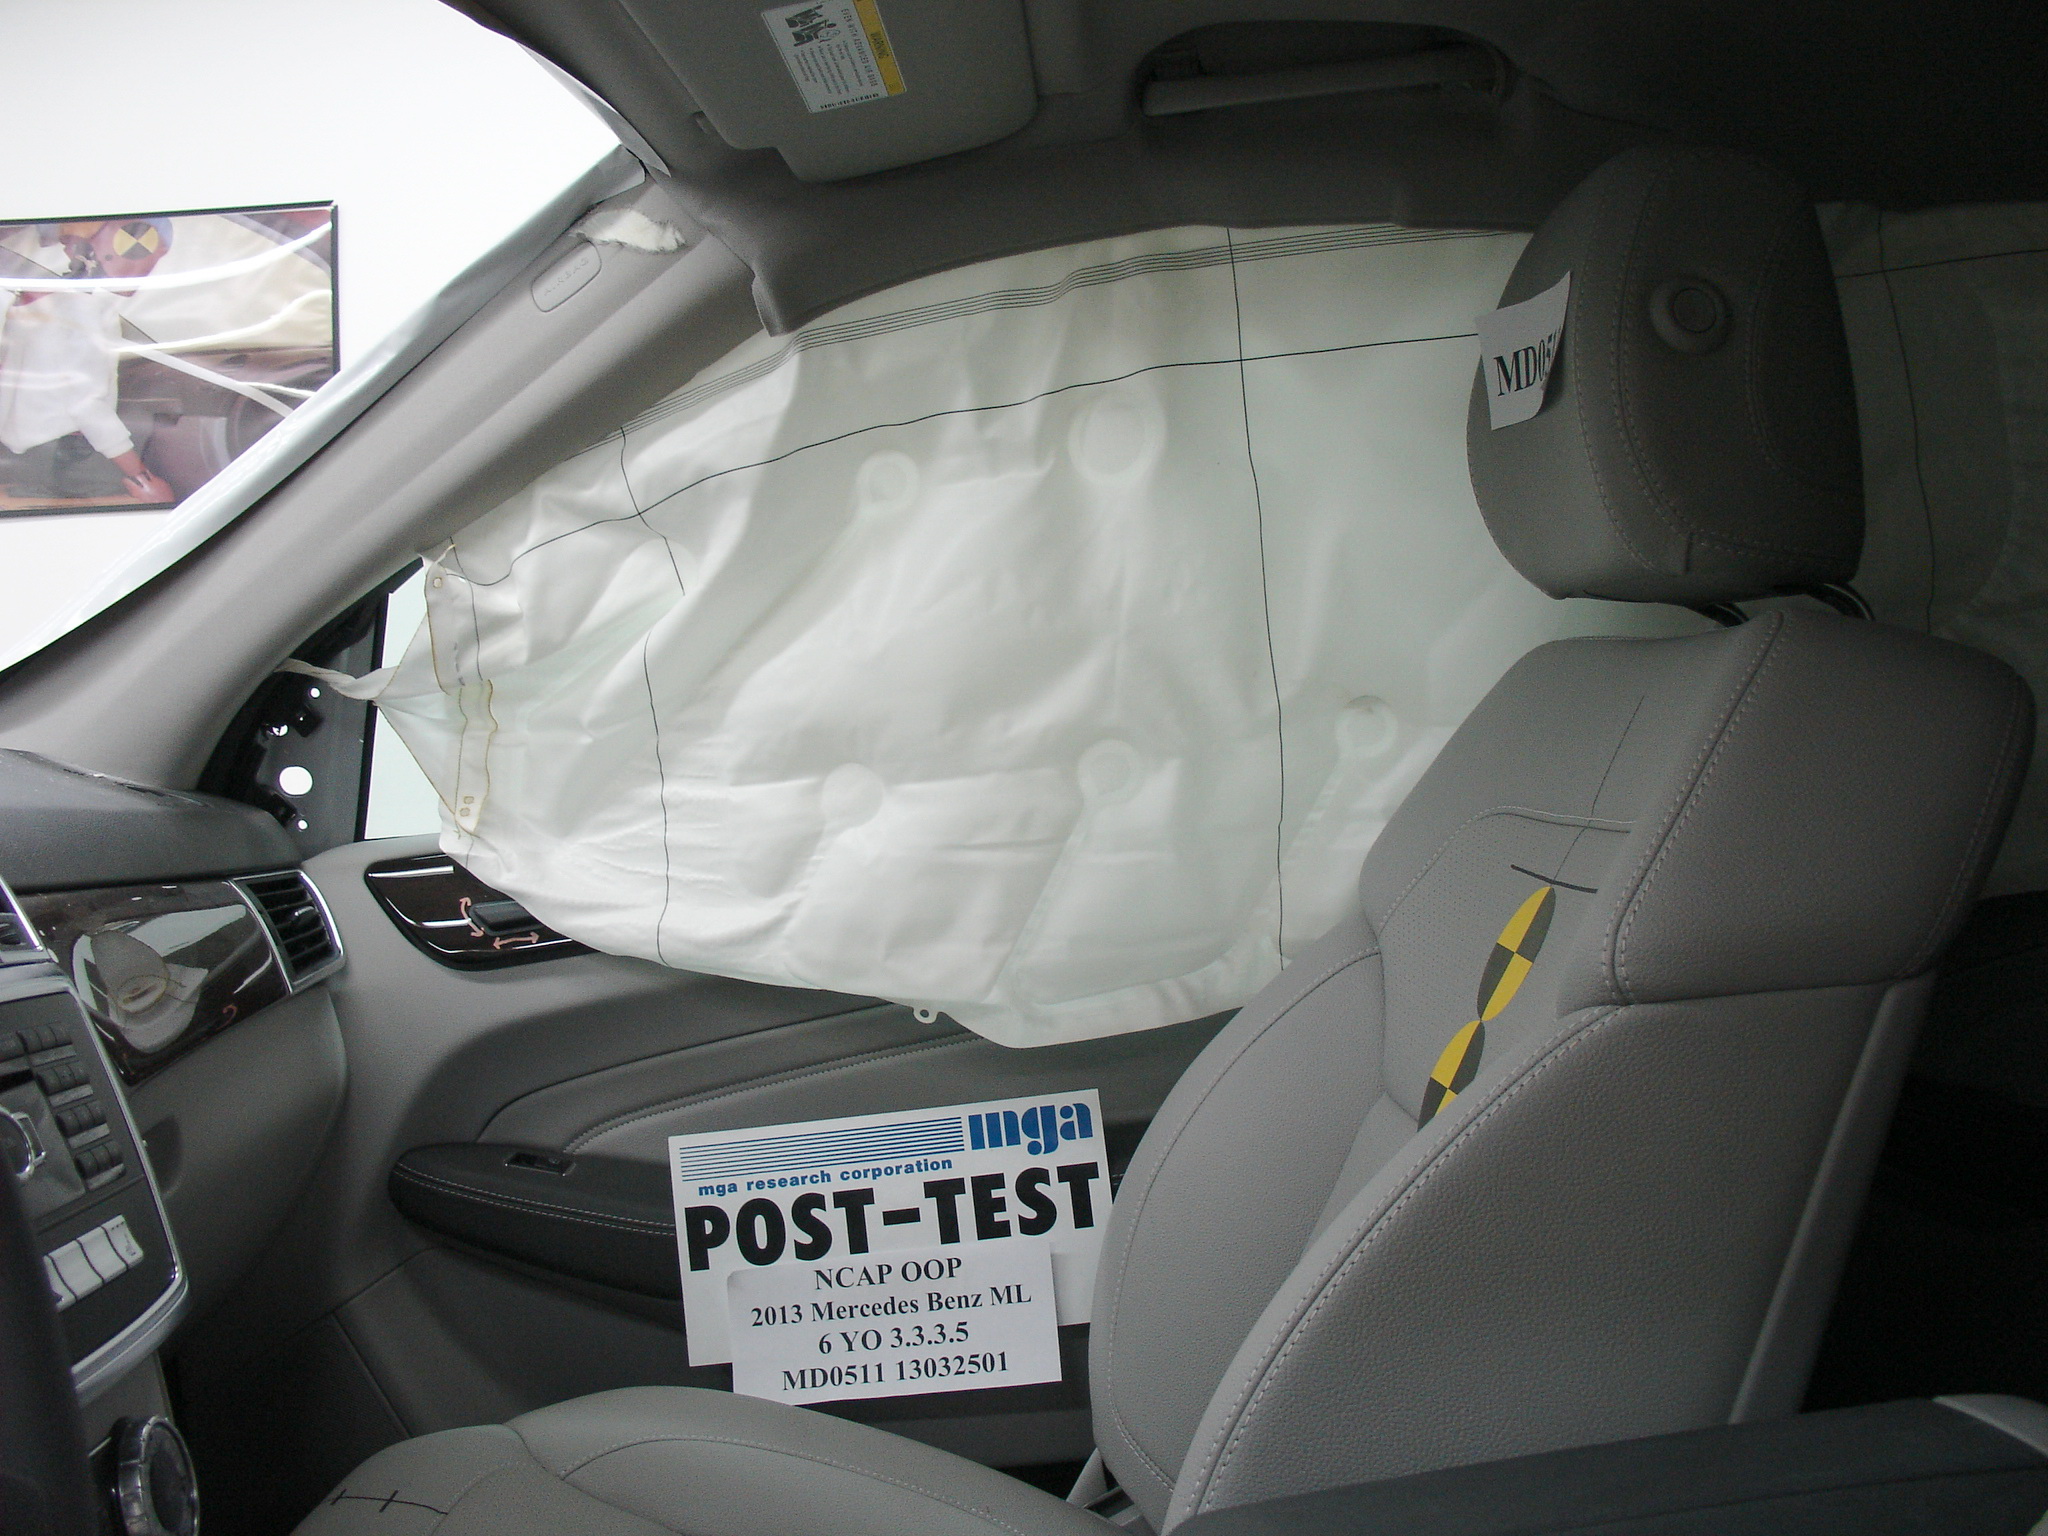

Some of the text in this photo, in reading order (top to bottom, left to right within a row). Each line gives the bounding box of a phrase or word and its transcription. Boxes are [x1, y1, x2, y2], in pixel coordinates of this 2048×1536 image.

[968, 1102, 1093, 1155] mga
[698, 1157, 953, 1197] mga research corporation
[684, 1162, 1099, 1272] POST-TEST
[814, 1257, 963, 1290] NCAP OOP
[751, 1284, 1032, 1327] 2013 Mercedes Benz ML
[819, 1321, 969, 1354] 6 YO 3.3.3.5
[783, 1351, 1009, 1391] MD0511 13032501
